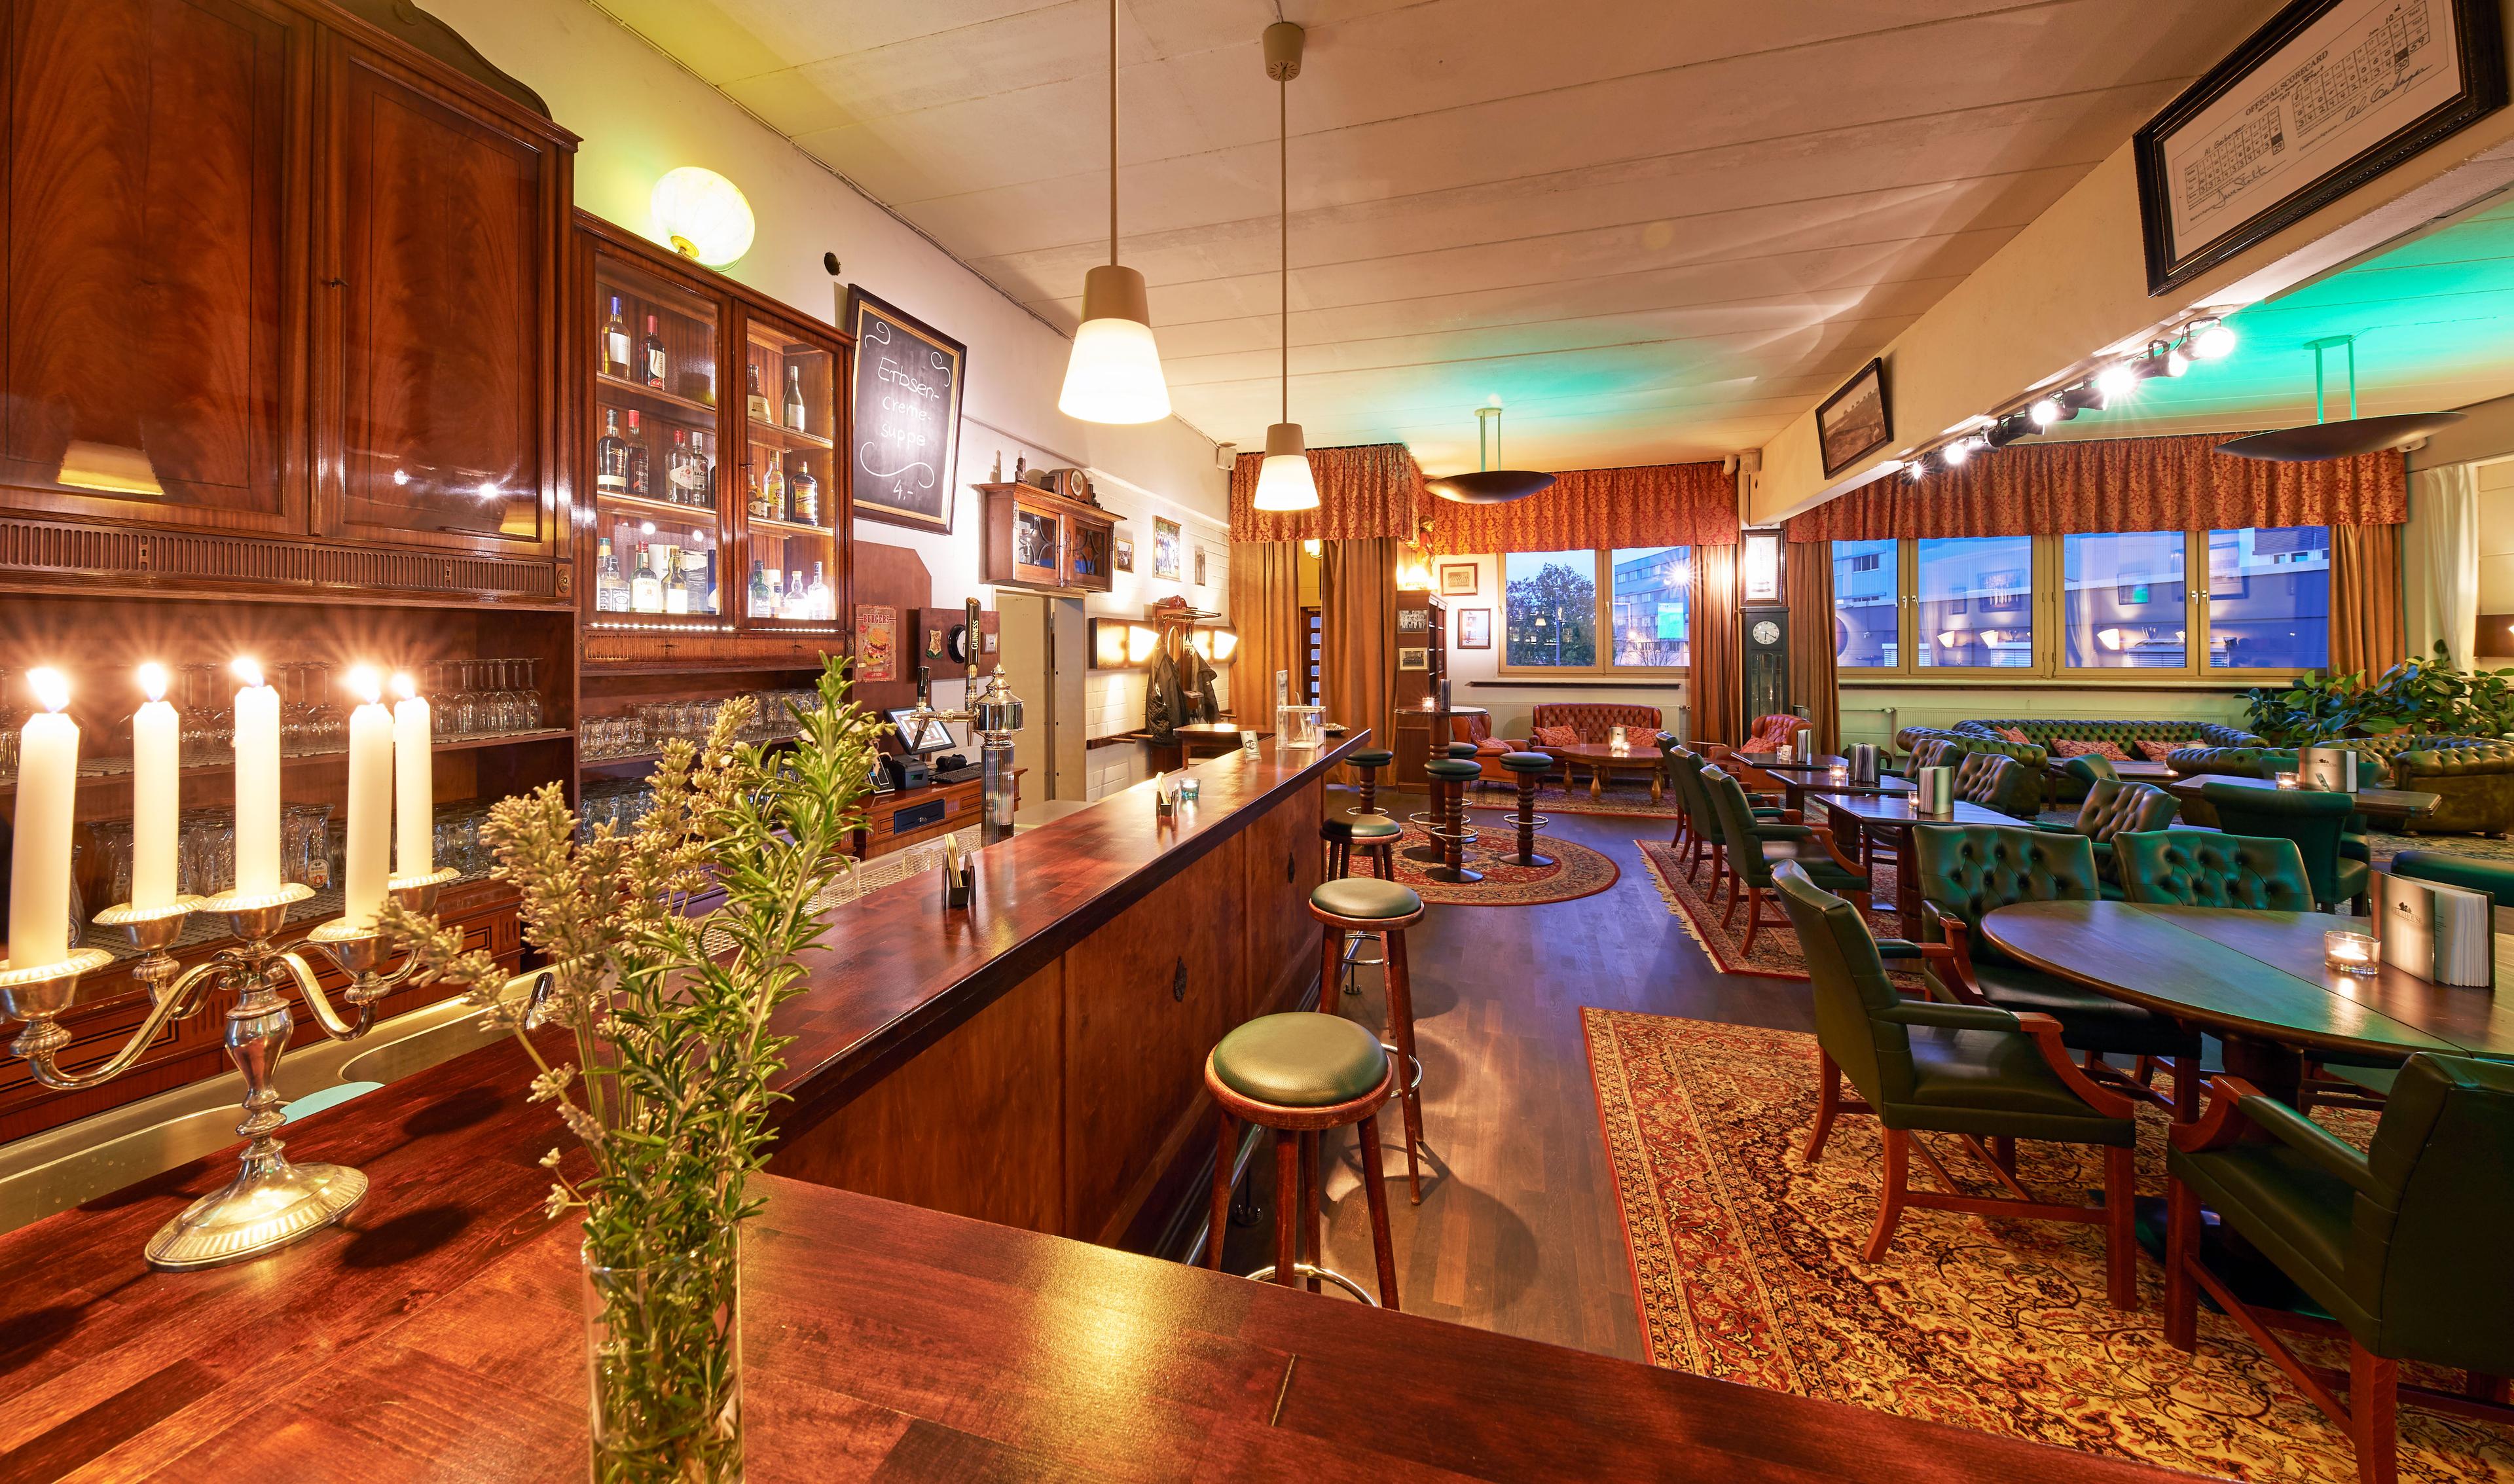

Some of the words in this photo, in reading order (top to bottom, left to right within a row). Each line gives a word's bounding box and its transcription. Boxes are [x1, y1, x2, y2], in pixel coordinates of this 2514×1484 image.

[2246, 86, 2280, 116] OFFICIAL
[2280, 50, 2329, 90] SCORECARD
[2303, 65, 2323, 84] Start
[2204, 147, 2210, 156] Al
[2214, 124, 2246, 149] Geiberger
[877, 357, 939, 403] Erbsen-
[882, 395, 932, 422] creme-
[881, 423, 926, 450] suppe
[863, 614, 890, 624] BURGERS
